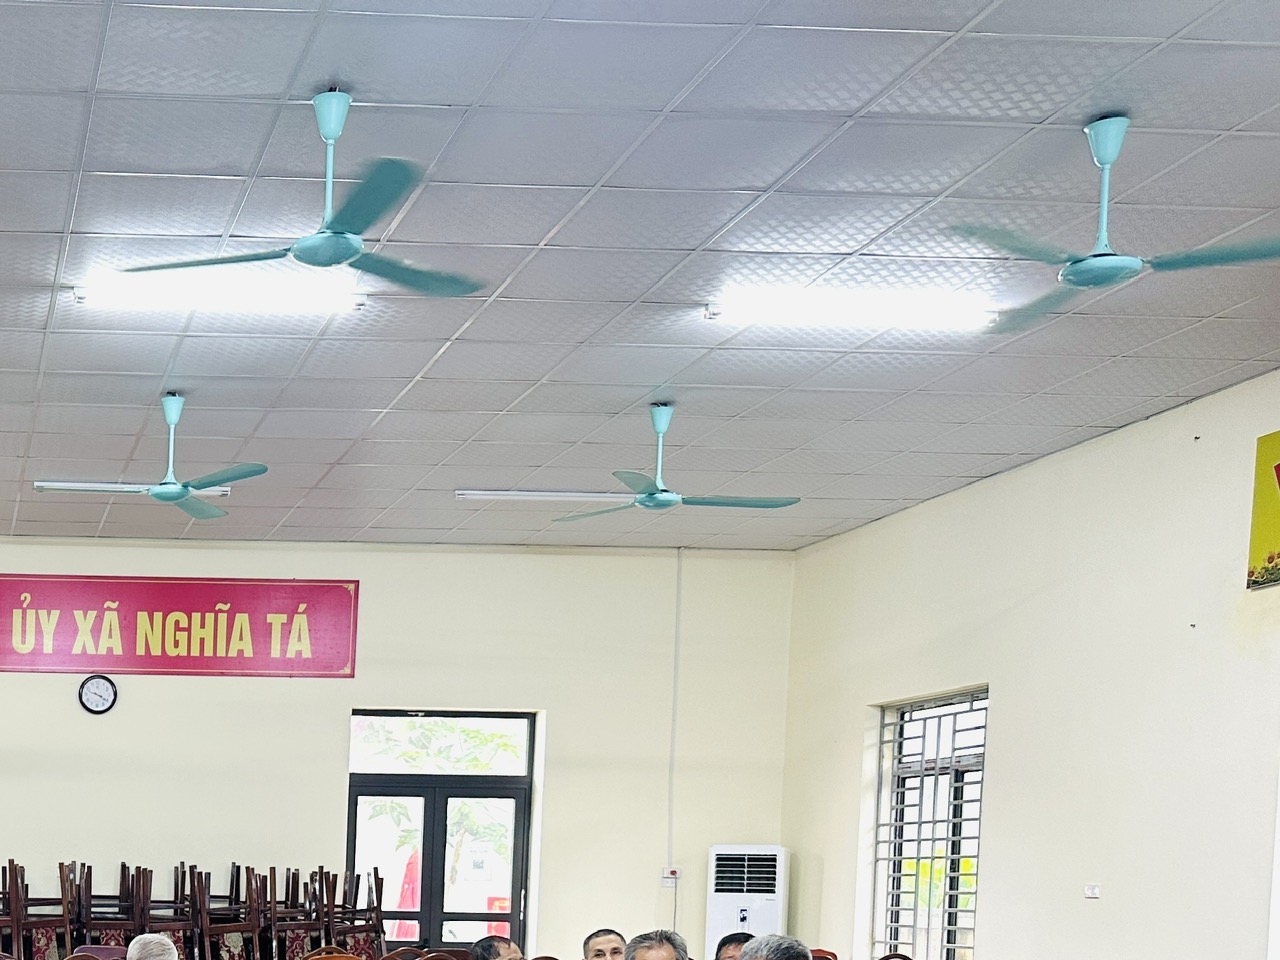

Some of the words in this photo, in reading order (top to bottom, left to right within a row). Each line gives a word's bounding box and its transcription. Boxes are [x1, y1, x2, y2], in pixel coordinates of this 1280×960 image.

[13, 592, 60, 654] ỦY
[71, 600, 123, 656] XÃ
[136, 602, 254, 658] NGHĨA
[266, 603, 312, 658] TÁ
